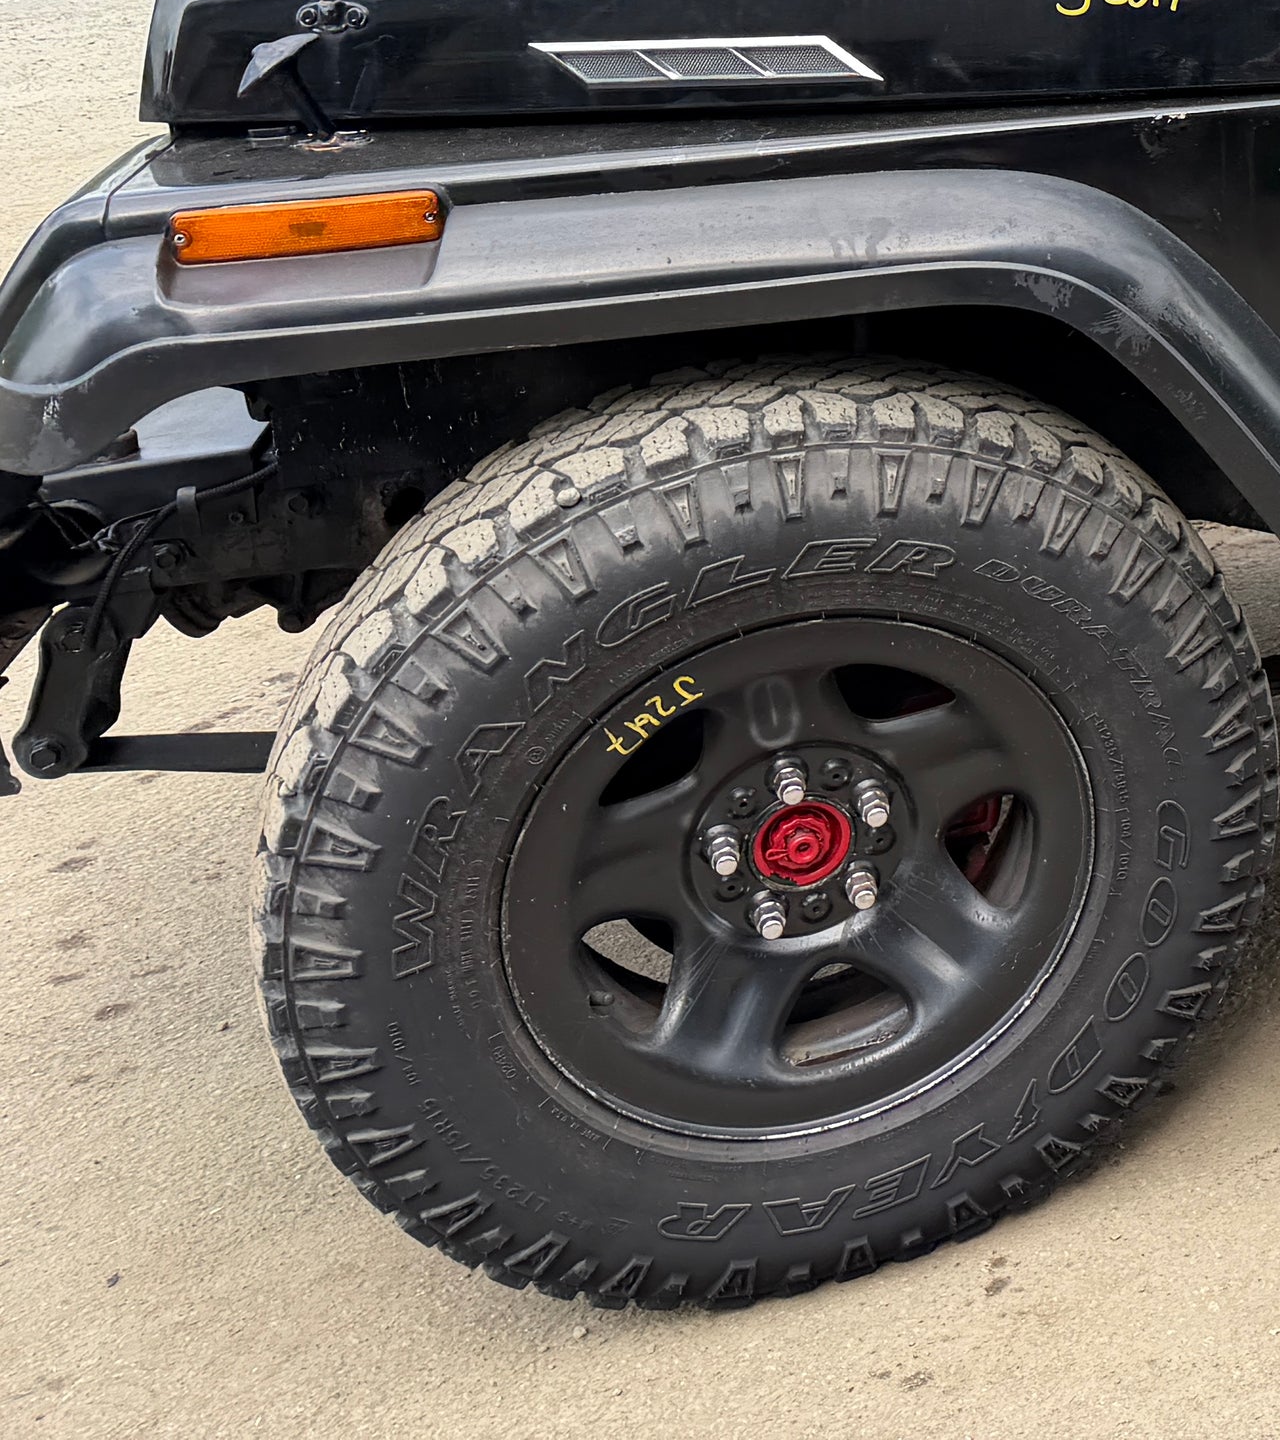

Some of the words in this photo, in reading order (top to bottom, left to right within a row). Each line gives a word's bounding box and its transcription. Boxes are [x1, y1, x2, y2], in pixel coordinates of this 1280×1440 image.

[391, 537, 957, 980] WRANGLER
[603, 675, 703, 755] J2617
[656, 799, 1192, 1242] GOODYEAR
